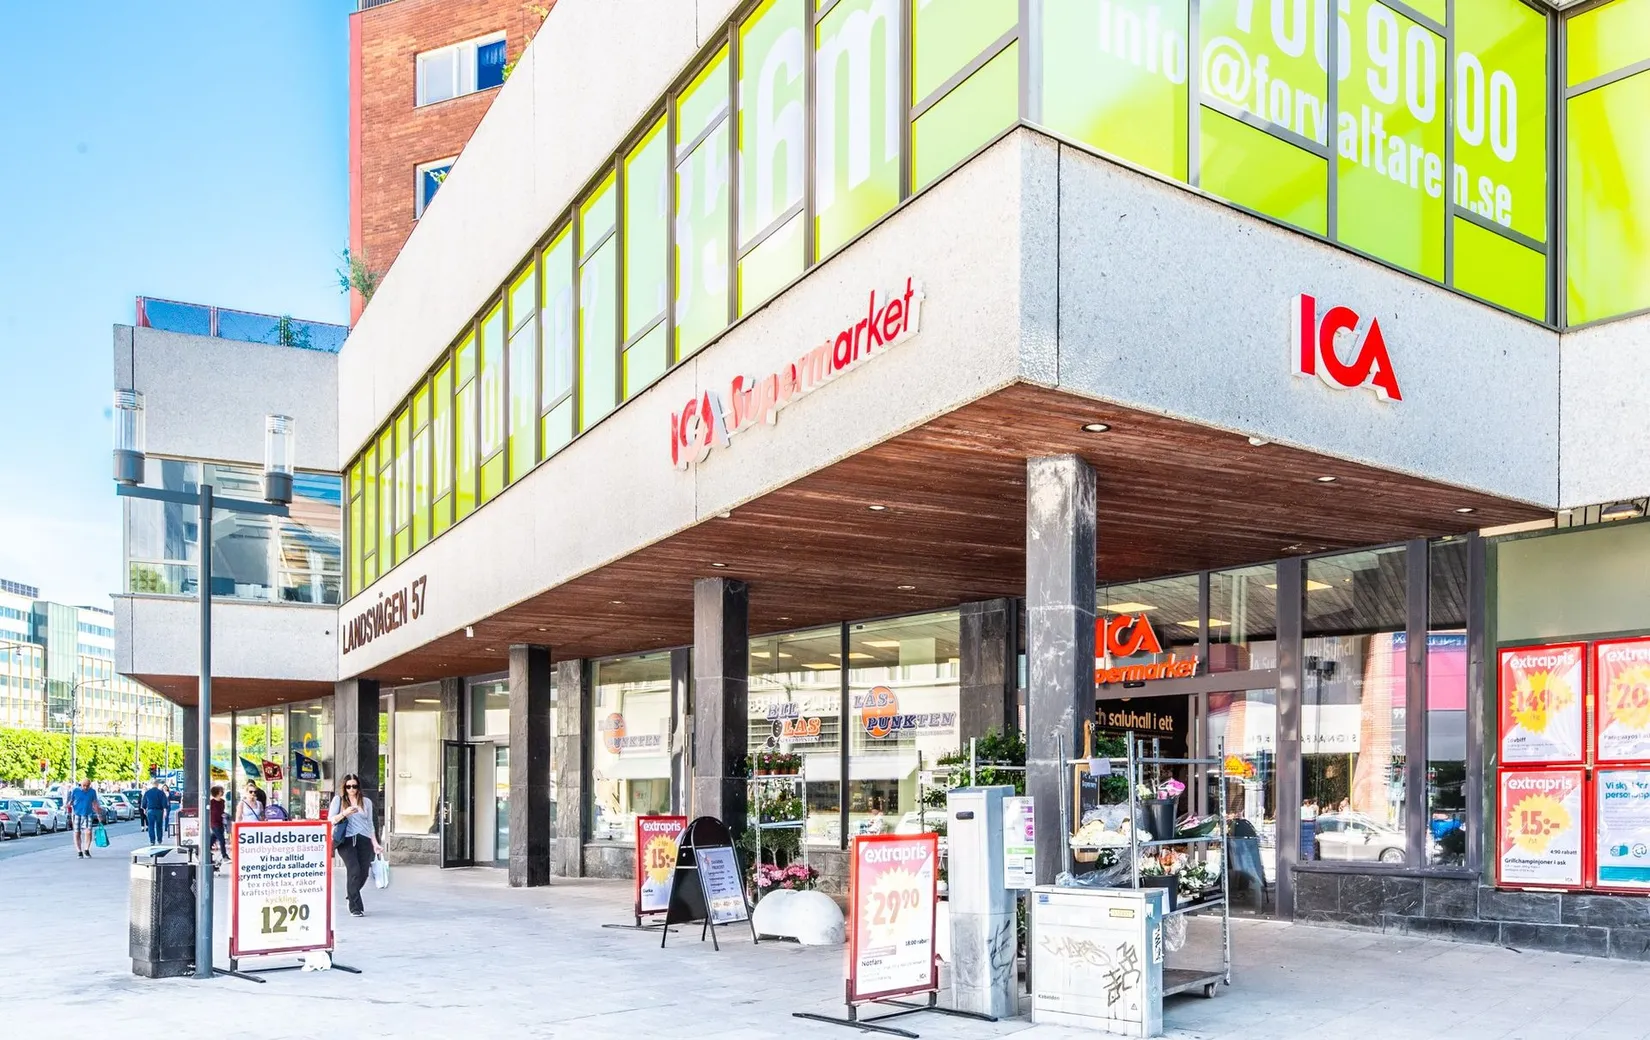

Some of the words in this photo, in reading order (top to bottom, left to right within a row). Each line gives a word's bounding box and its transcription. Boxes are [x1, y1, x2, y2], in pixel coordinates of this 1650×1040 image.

[1366, 0, 1436, 123] 90
[1456, 50, 1518, 163] 00
[1292, 293, 1403, 402] ICA
[671, 389, 729, 471] ICA
[728, 276, 925, 430] Supermarket
[342, 586, 408, 656] LANDSVÄGEN
[411, 573, 428, 621] 57
[1095, 612, 1163, 657] ICA
[1509, 651, 1575, 670] extrapris
[1095, 652, 1200, 689] permarket
[766, 702, 800, 721] BIL
[1108, 709, 1152, 730] saluhall
[1153, 712, 1158, 730] i
[1158, 714, 1175, 732] ett
[865, 712, 957, 732] PUNKTEN
[1508, 778, 1573, 792] extrapris
[1605, 781, 1615, 790] Vi
[642, 820, 682, 833] extrapris
[1520, 810, 1561, 837] 15:-
[238, 831, 327, 844] Salladsbaren
[240, 845, 295, 855] Sundbybergs
[260, 854, 269, 862] Vi
[269, 854, 283, 862] har
[284, 853, 305, 862] alltid
[651, 847, 677, 869] 15:-
[864, 842, 928, 865] extrapris
[1561, 848, 1578, 856] rabatt
[241, 862, 286, 873] egengjorda
[287, 862, 318, 870] sallader
[1504, 857, 1553, 867] Grillchampinjoner
[262, 880, 279, 888] rökt
[280, 879, 295, 887] lax,
[263, 872, 291, 881] mycket
[298, 886, 324, 894] svensk
